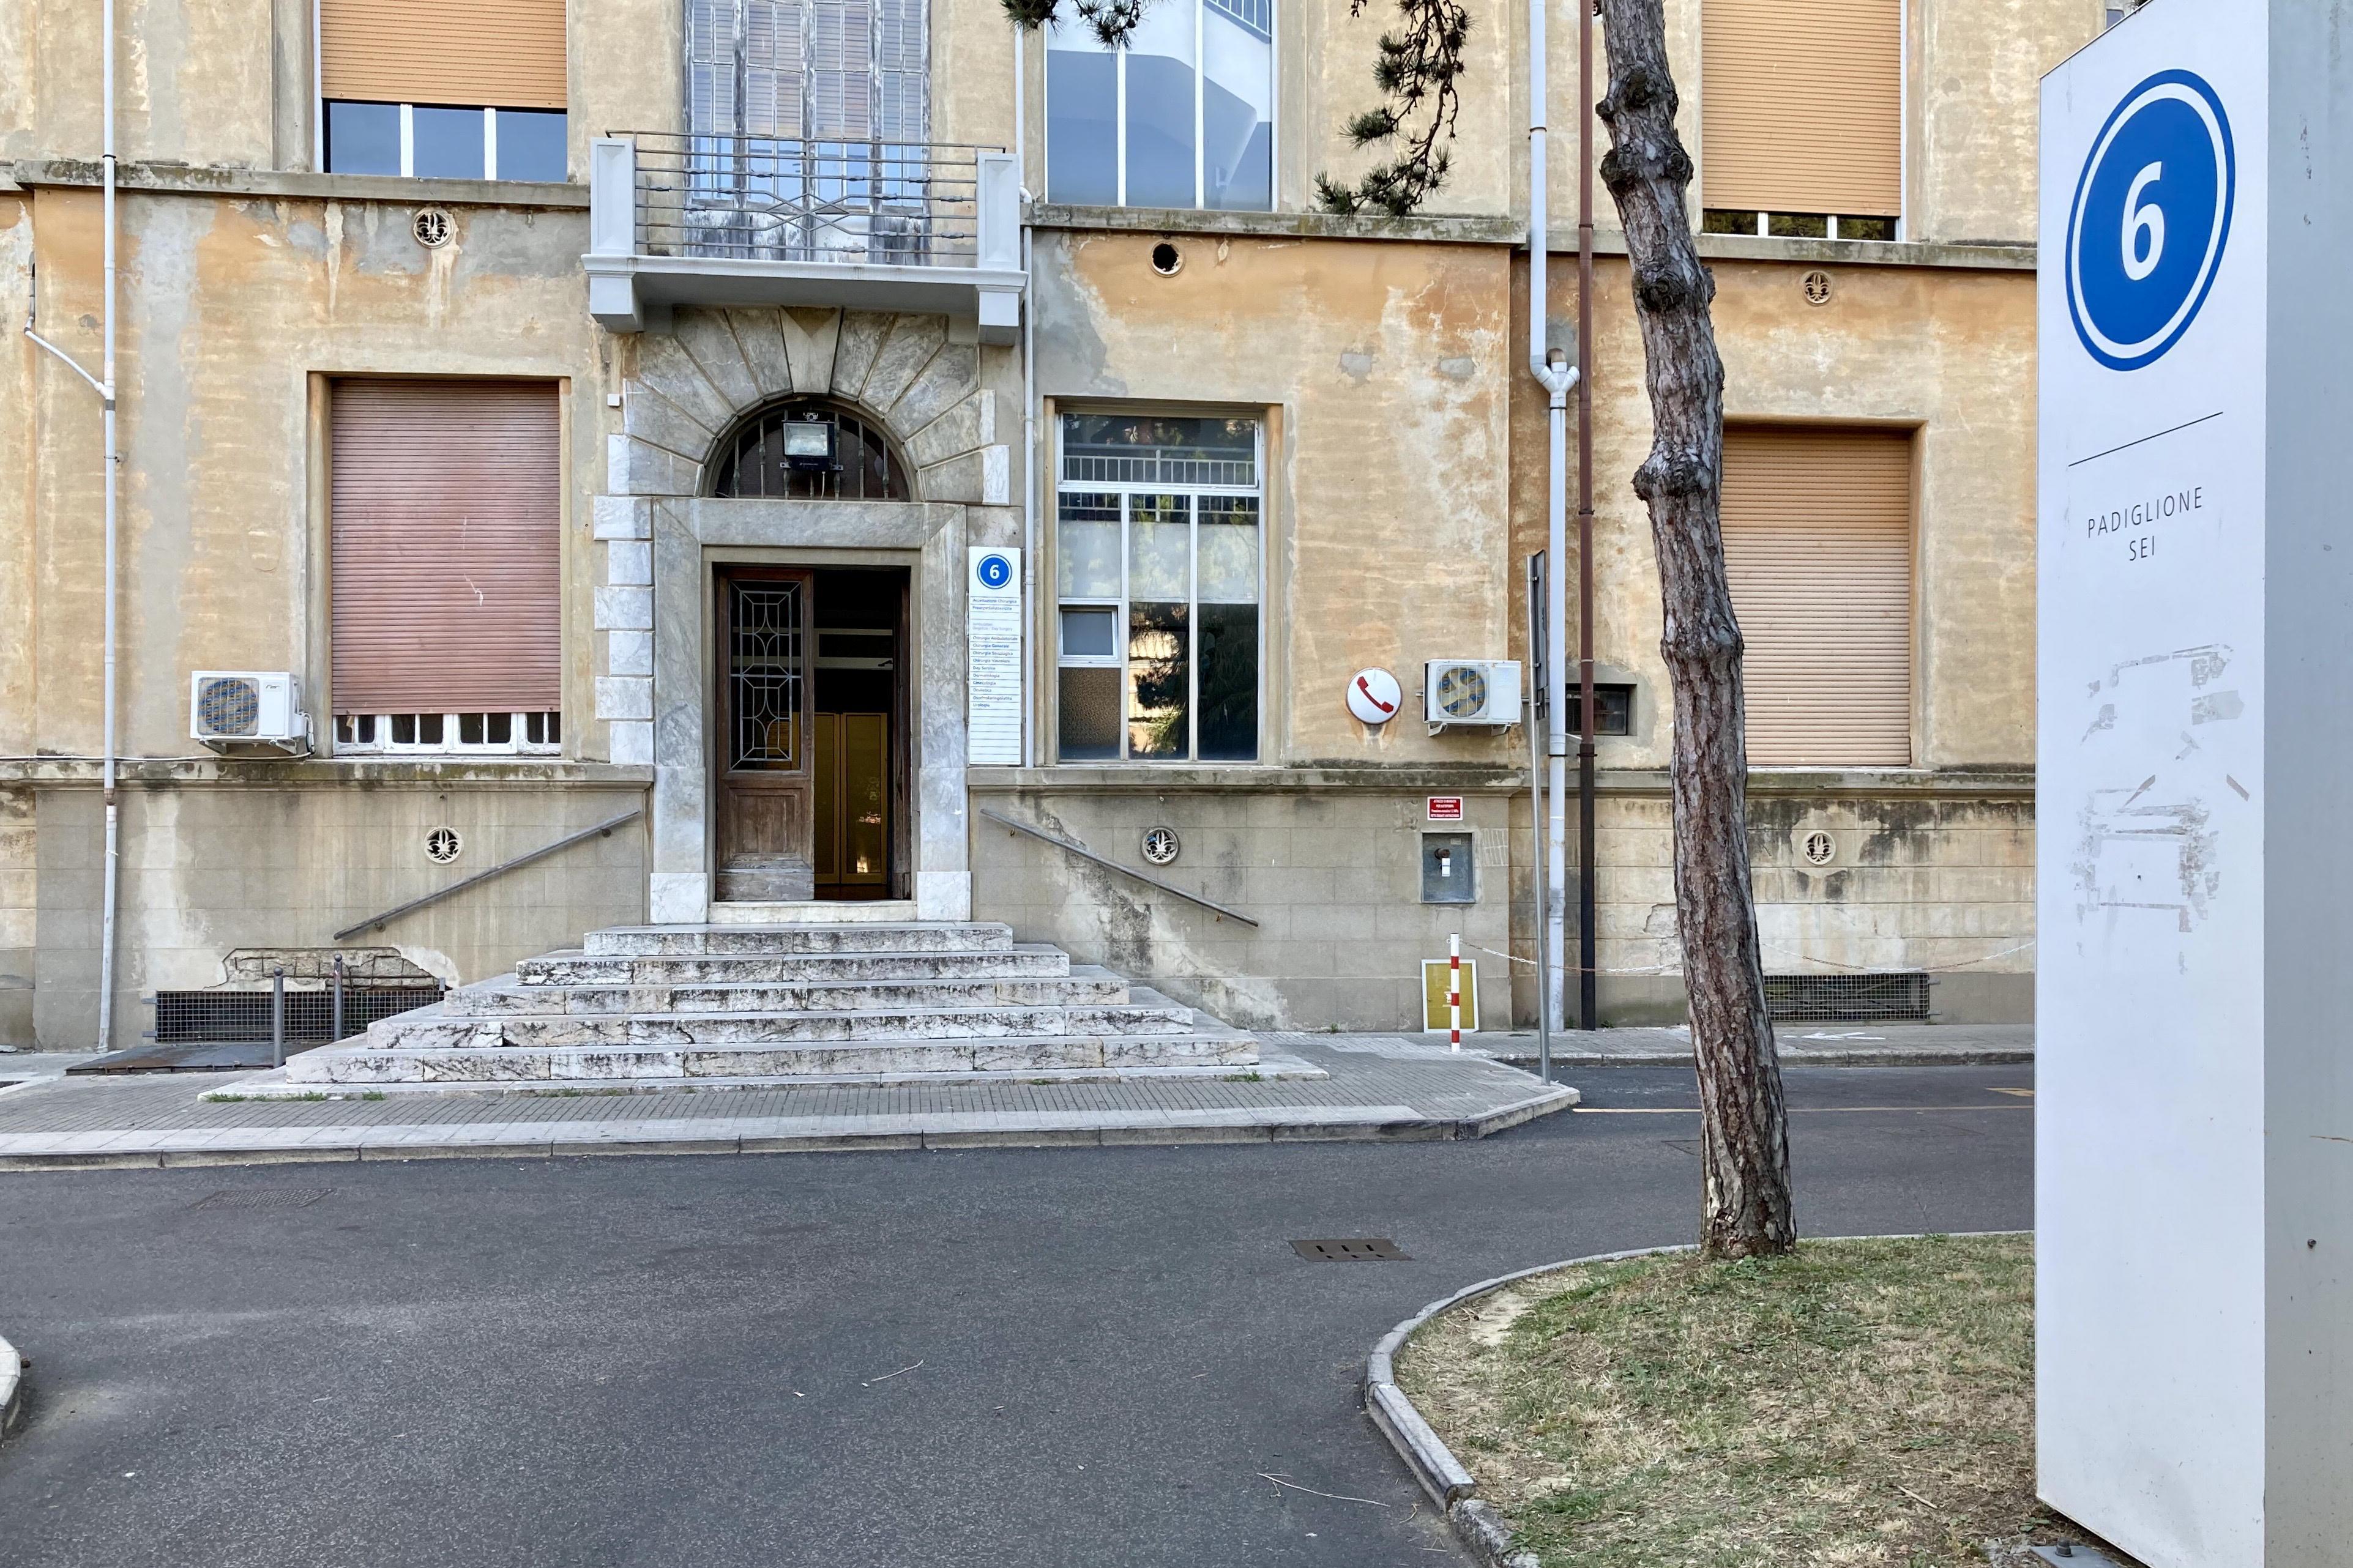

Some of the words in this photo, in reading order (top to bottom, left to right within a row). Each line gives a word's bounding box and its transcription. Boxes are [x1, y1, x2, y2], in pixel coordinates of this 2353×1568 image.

[2120, 161, 2165, 281] 6
[2087, 486, 2202, 539] PADIGLIONE
[2129, 535, 2155, 562] SEI
[990, 564, 1000, 579] 6
